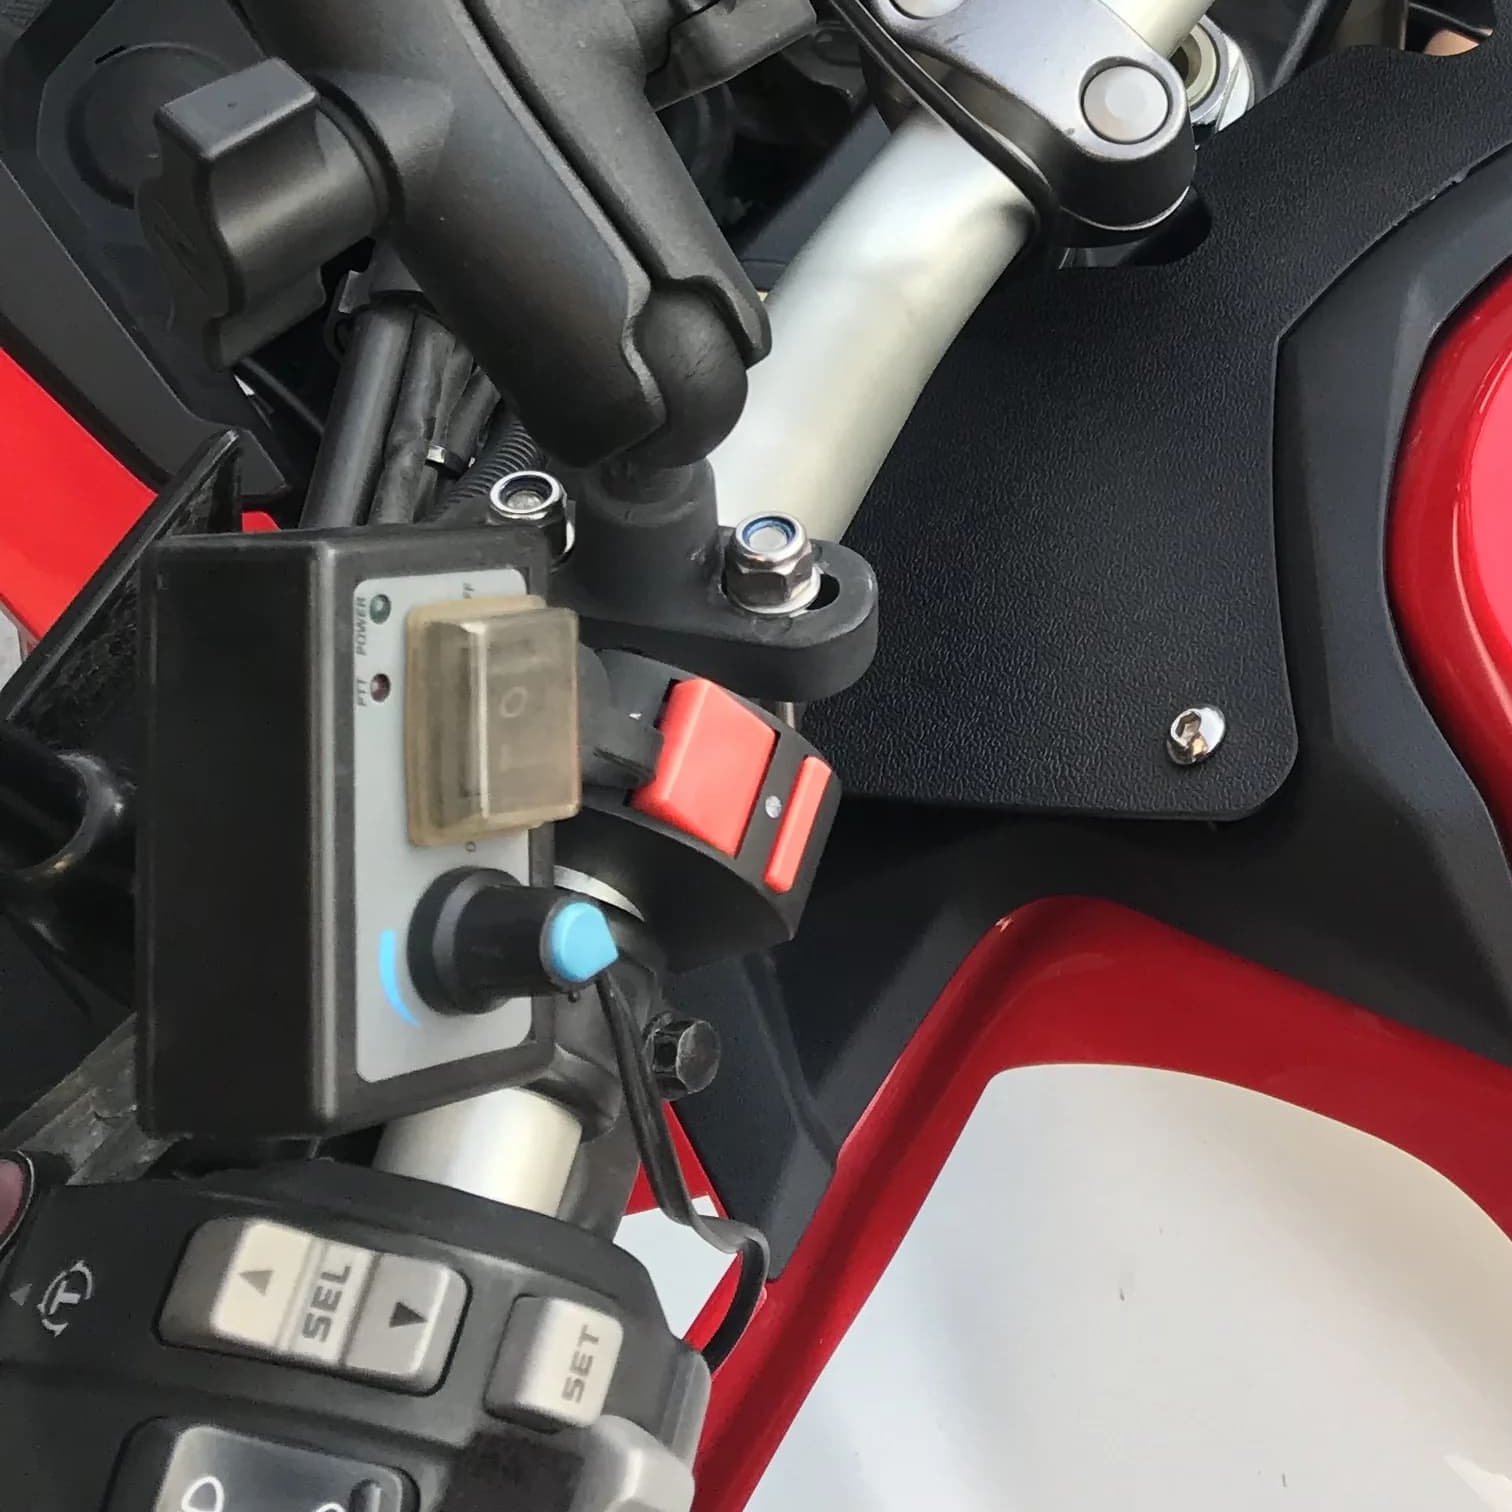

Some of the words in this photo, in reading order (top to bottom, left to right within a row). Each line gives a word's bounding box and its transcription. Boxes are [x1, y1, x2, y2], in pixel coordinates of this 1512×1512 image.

[355, 596, 369, 657] POWER
[356, 678, 369, 708] PTT
[301, 1264, 352, 1344] SEL
[560, 1322, 600, 1405] SET
